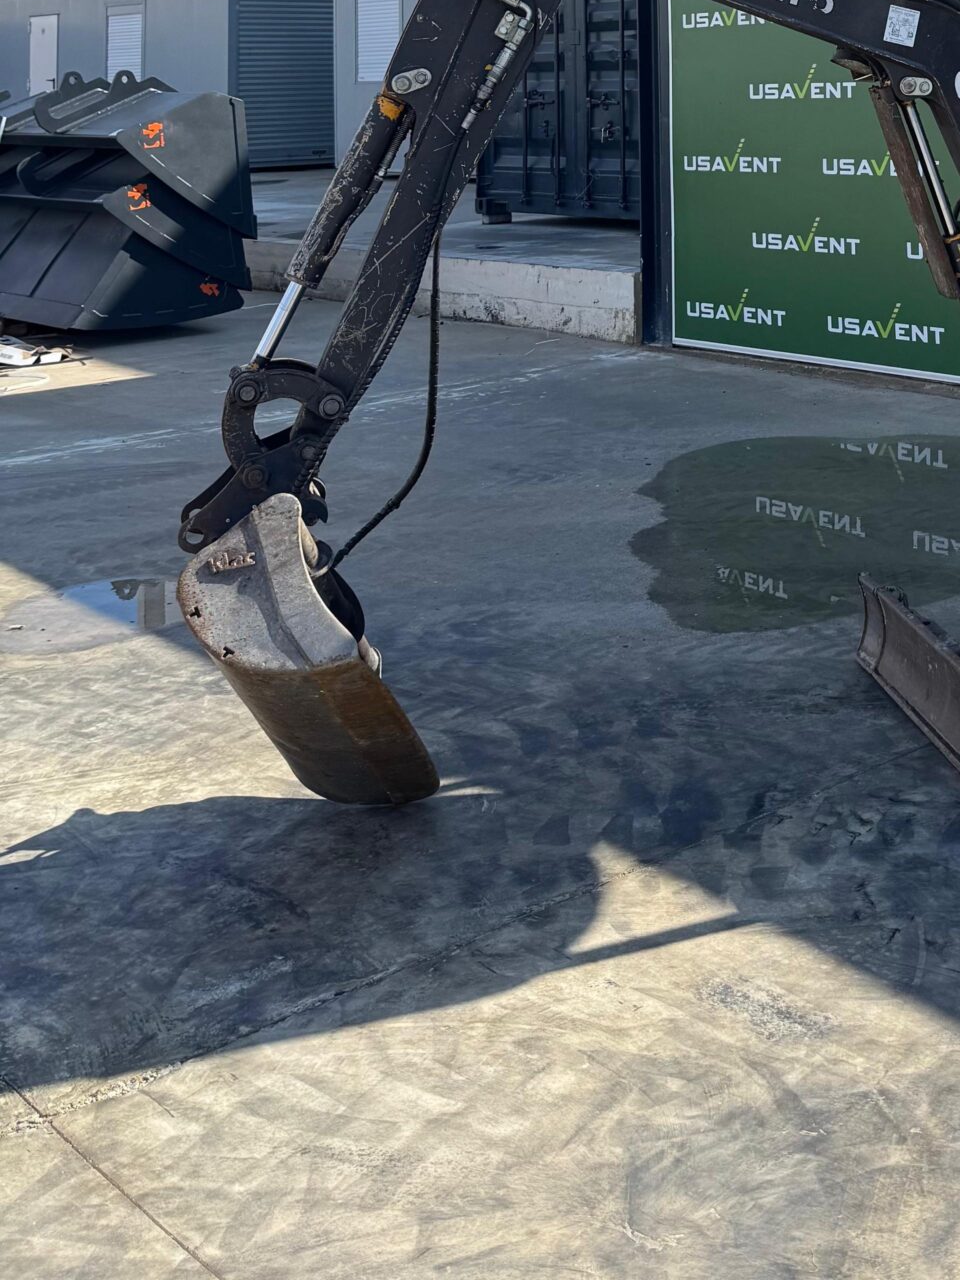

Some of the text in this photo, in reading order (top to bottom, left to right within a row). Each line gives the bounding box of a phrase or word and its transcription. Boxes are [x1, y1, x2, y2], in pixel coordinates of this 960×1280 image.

[749, 80, 857, 100] USAVENT
[683, 153, 782, 174] USAVENT
[752, 231, 860, 256] USAVENT
[687, 300, 786, 327] USAVENT
[827, 315, 945, 345] USAVENT
